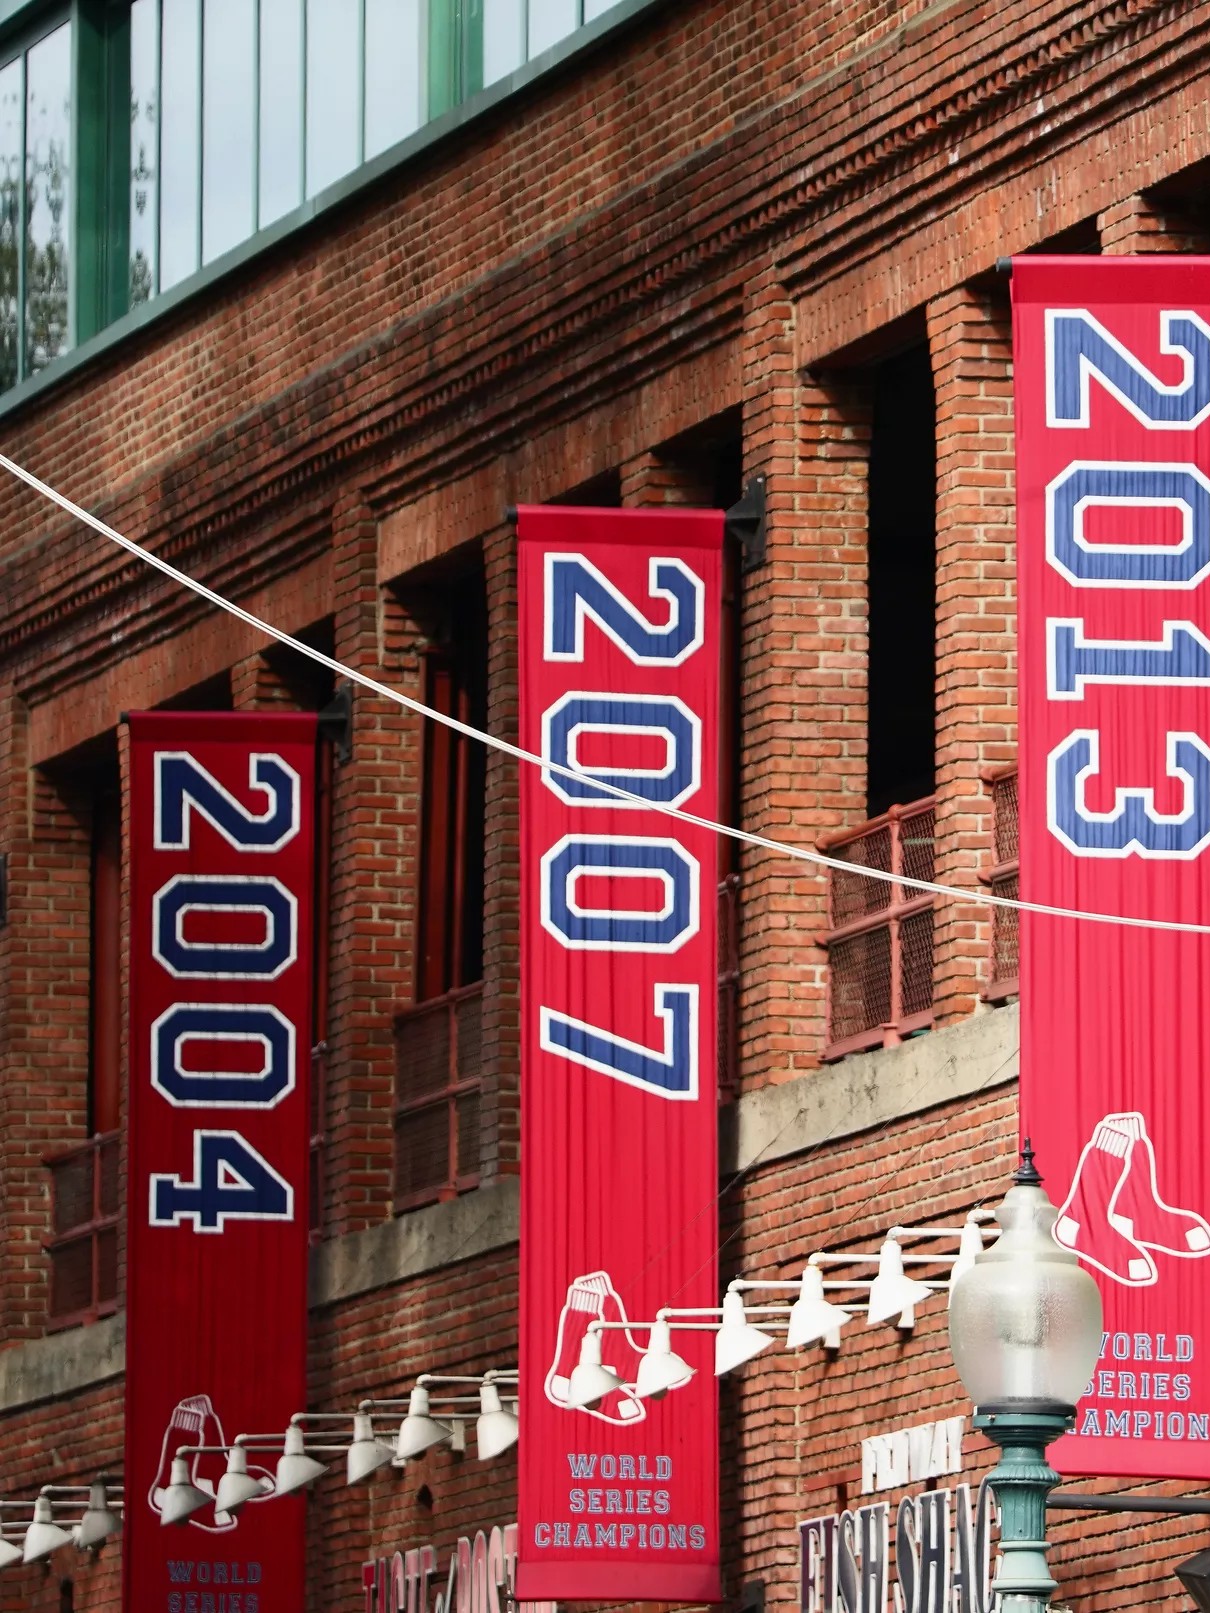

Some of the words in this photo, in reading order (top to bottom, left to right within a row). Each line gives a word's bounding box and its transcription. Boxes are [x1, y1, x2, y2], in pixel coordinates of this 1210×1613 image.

[540, 552, 704, 1100] 2007
[149, 751, 300, 1234] 2004
[567, 1453, 672, 1480] WORLD
[569, 1489, 670, 1514] SERIES
[534, 1523, 706, 1549] CHAMPIONS
[893, 1476, 1002, 1613] SHAC
[167, 1560, 262, 1584] WORLD
[167, 1591, 259, 1613] SERIES
